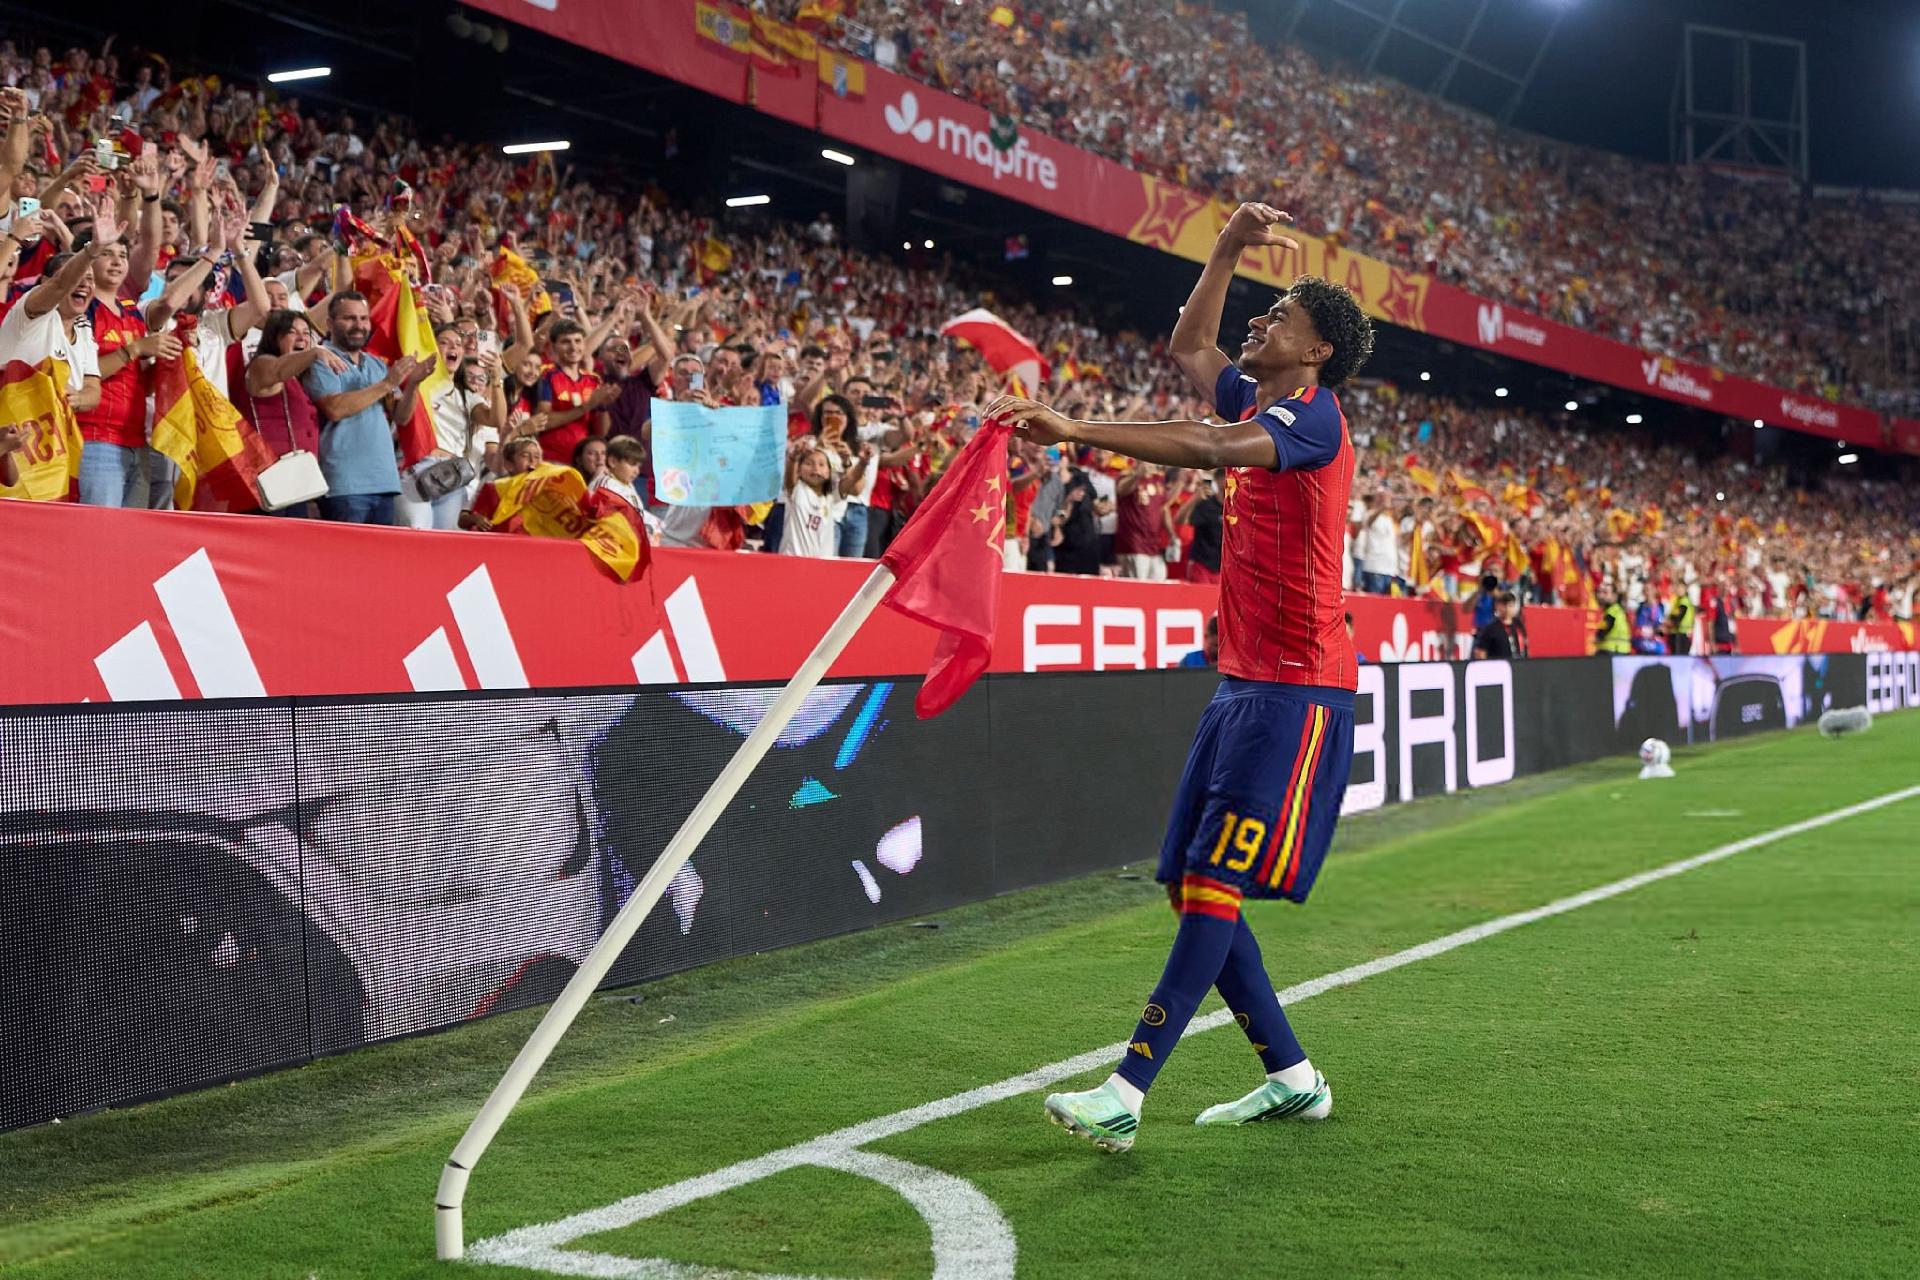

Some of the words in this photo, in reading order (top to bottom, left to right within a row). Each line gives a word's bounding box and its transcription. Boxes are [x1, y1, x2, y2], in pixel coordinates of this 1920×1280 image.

[938, 117, 1058, 190] mapfre
[805, 514, 822, 532] 19
[1340, 660, 1515, 816] BRO
[1209, 812, 1266, 872] 19
